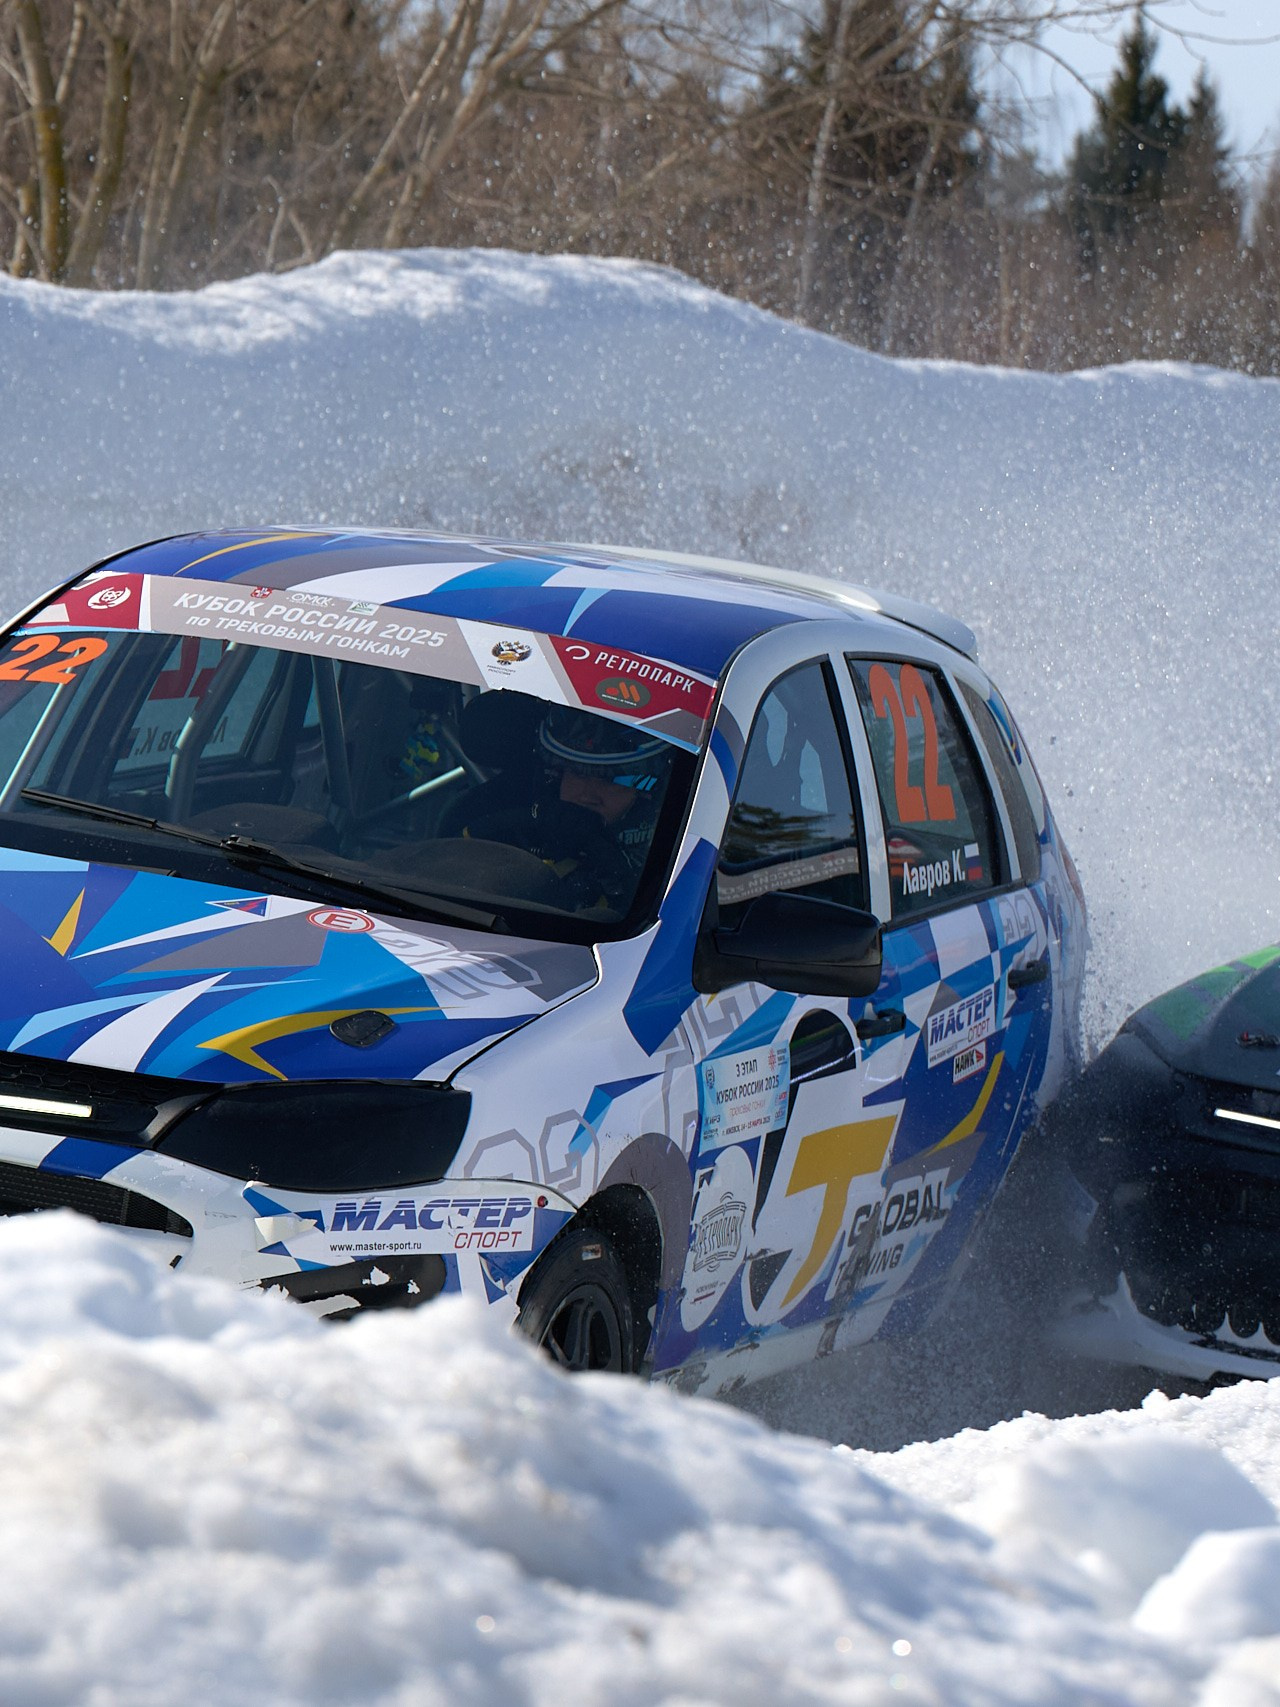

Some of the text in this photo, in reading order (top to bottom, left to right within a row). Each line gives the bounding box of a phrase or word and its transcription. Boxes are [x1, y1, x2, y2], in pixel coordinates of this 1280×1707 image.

[173, 592, 448, 648] КУБОК РОССИИ 2025
[185, 616, 411, 658] по ТРЕКОВЫМ ГОНКАМ
[0, 635, 108, 684] 22
[594, 651, 696, 693] РЕТРОПАРК
[869, 664, 956, 823] 22
[903, 849, 966, 896] Лавров К.
[930, 987, 993, 1046] МАСТЕР
[741, 1059, 758, 1076] ЭТАП
[716, 1087, 738, 1105] КУБОК
[739, 1079, 764, 1099] РОССИИ
[765, 1075, 780, 1091] 2025
[330, 1198, 532, 1231] МАСТЕР
[330, 1240, 422, 1252] www.master-sport.ru
[454, 1231, 522, 1248] СПОРТ
